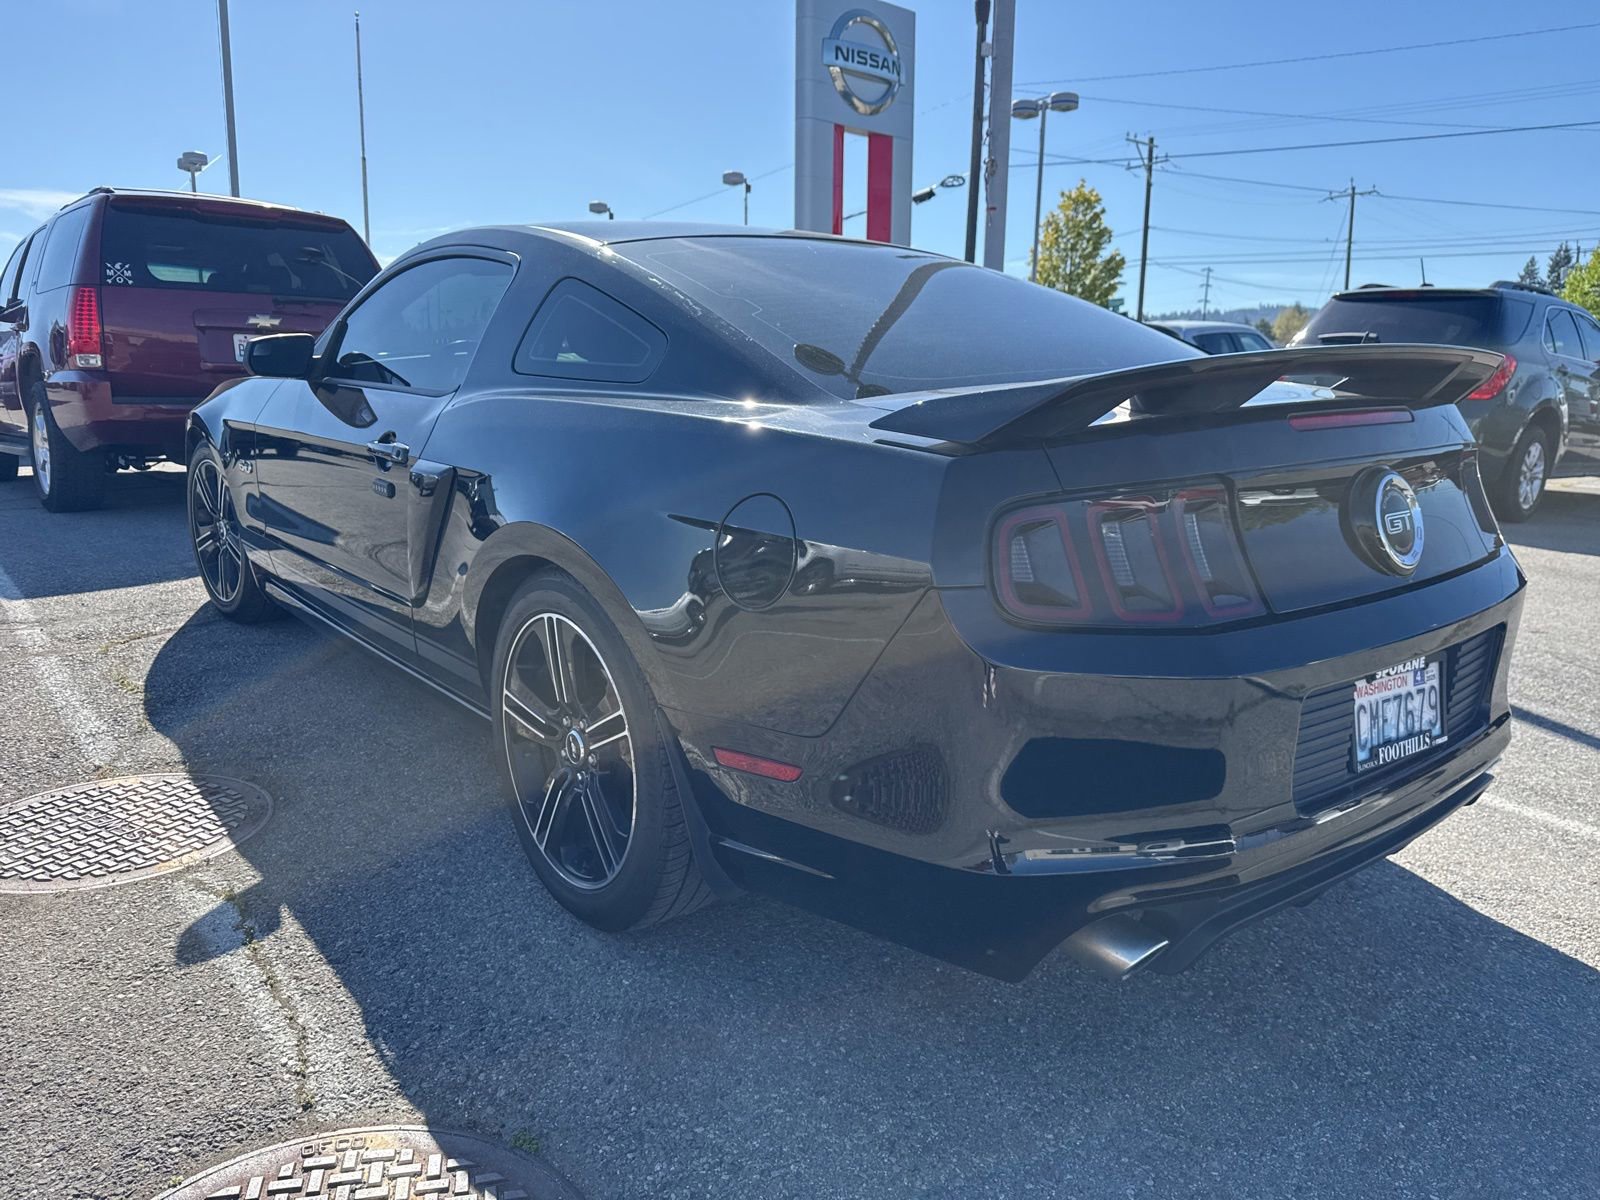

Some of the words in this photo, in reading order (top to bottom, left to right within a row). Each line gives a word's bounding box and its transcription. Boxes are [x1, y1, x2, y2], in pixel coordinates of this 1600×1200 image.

[834, 45, 901, 77] NISSAN
[1385, 510, 1411, 535] GT
[1356, 675, 1408, 699] WASHINGTON
[1378, 732, 1431, 765] FOOTHILLS
